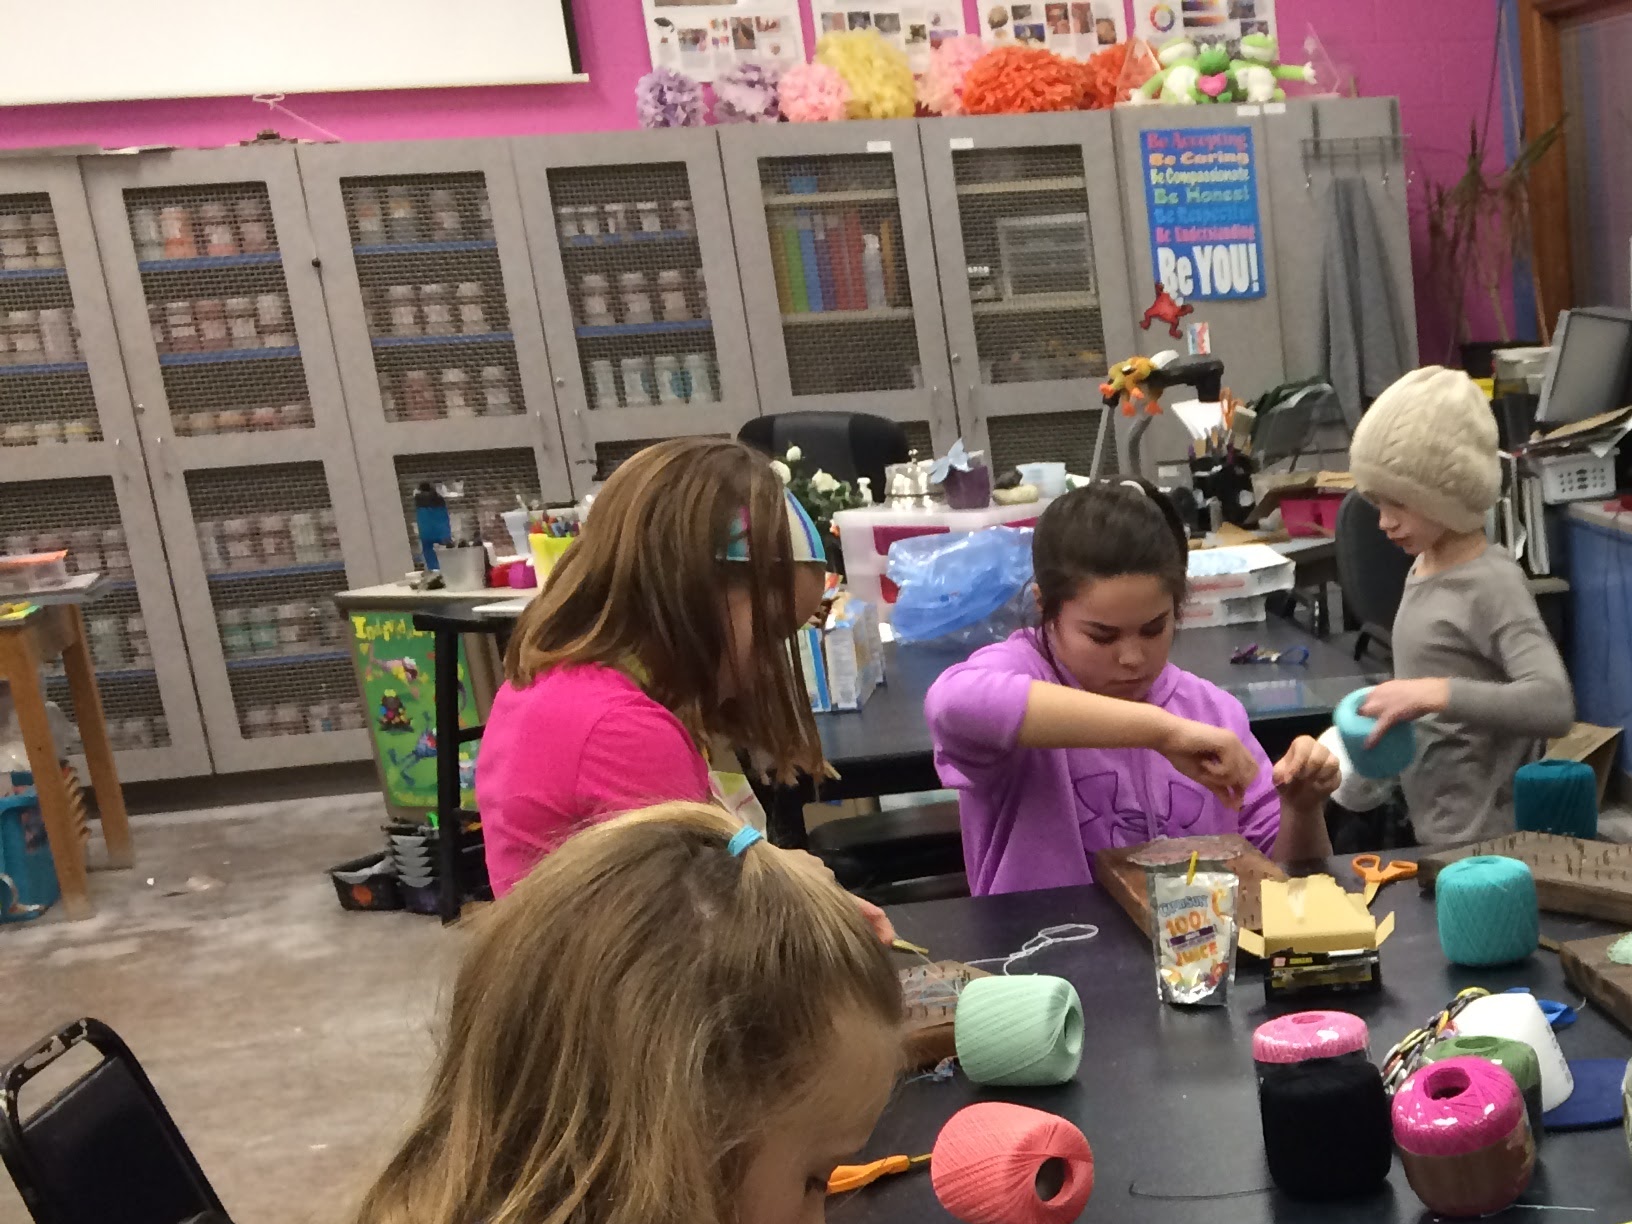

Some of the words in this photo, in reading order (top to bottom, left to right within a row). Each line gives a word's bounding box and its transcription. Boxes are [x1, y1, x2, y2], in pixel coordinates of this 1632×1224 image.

[1149, 153, 1176, 166] Be
[1180, 151, 1249, 164] Caring
[1151, 169, 1164, 185] Be
[1154, 188, 1179, 204] Be
[1185, 185, 1249, 203] Honest
[1156, 227, 1171, 242] Be
[1157, 246, 1194, 300] Be
[1192, 243, 1260, 295] YOU!
